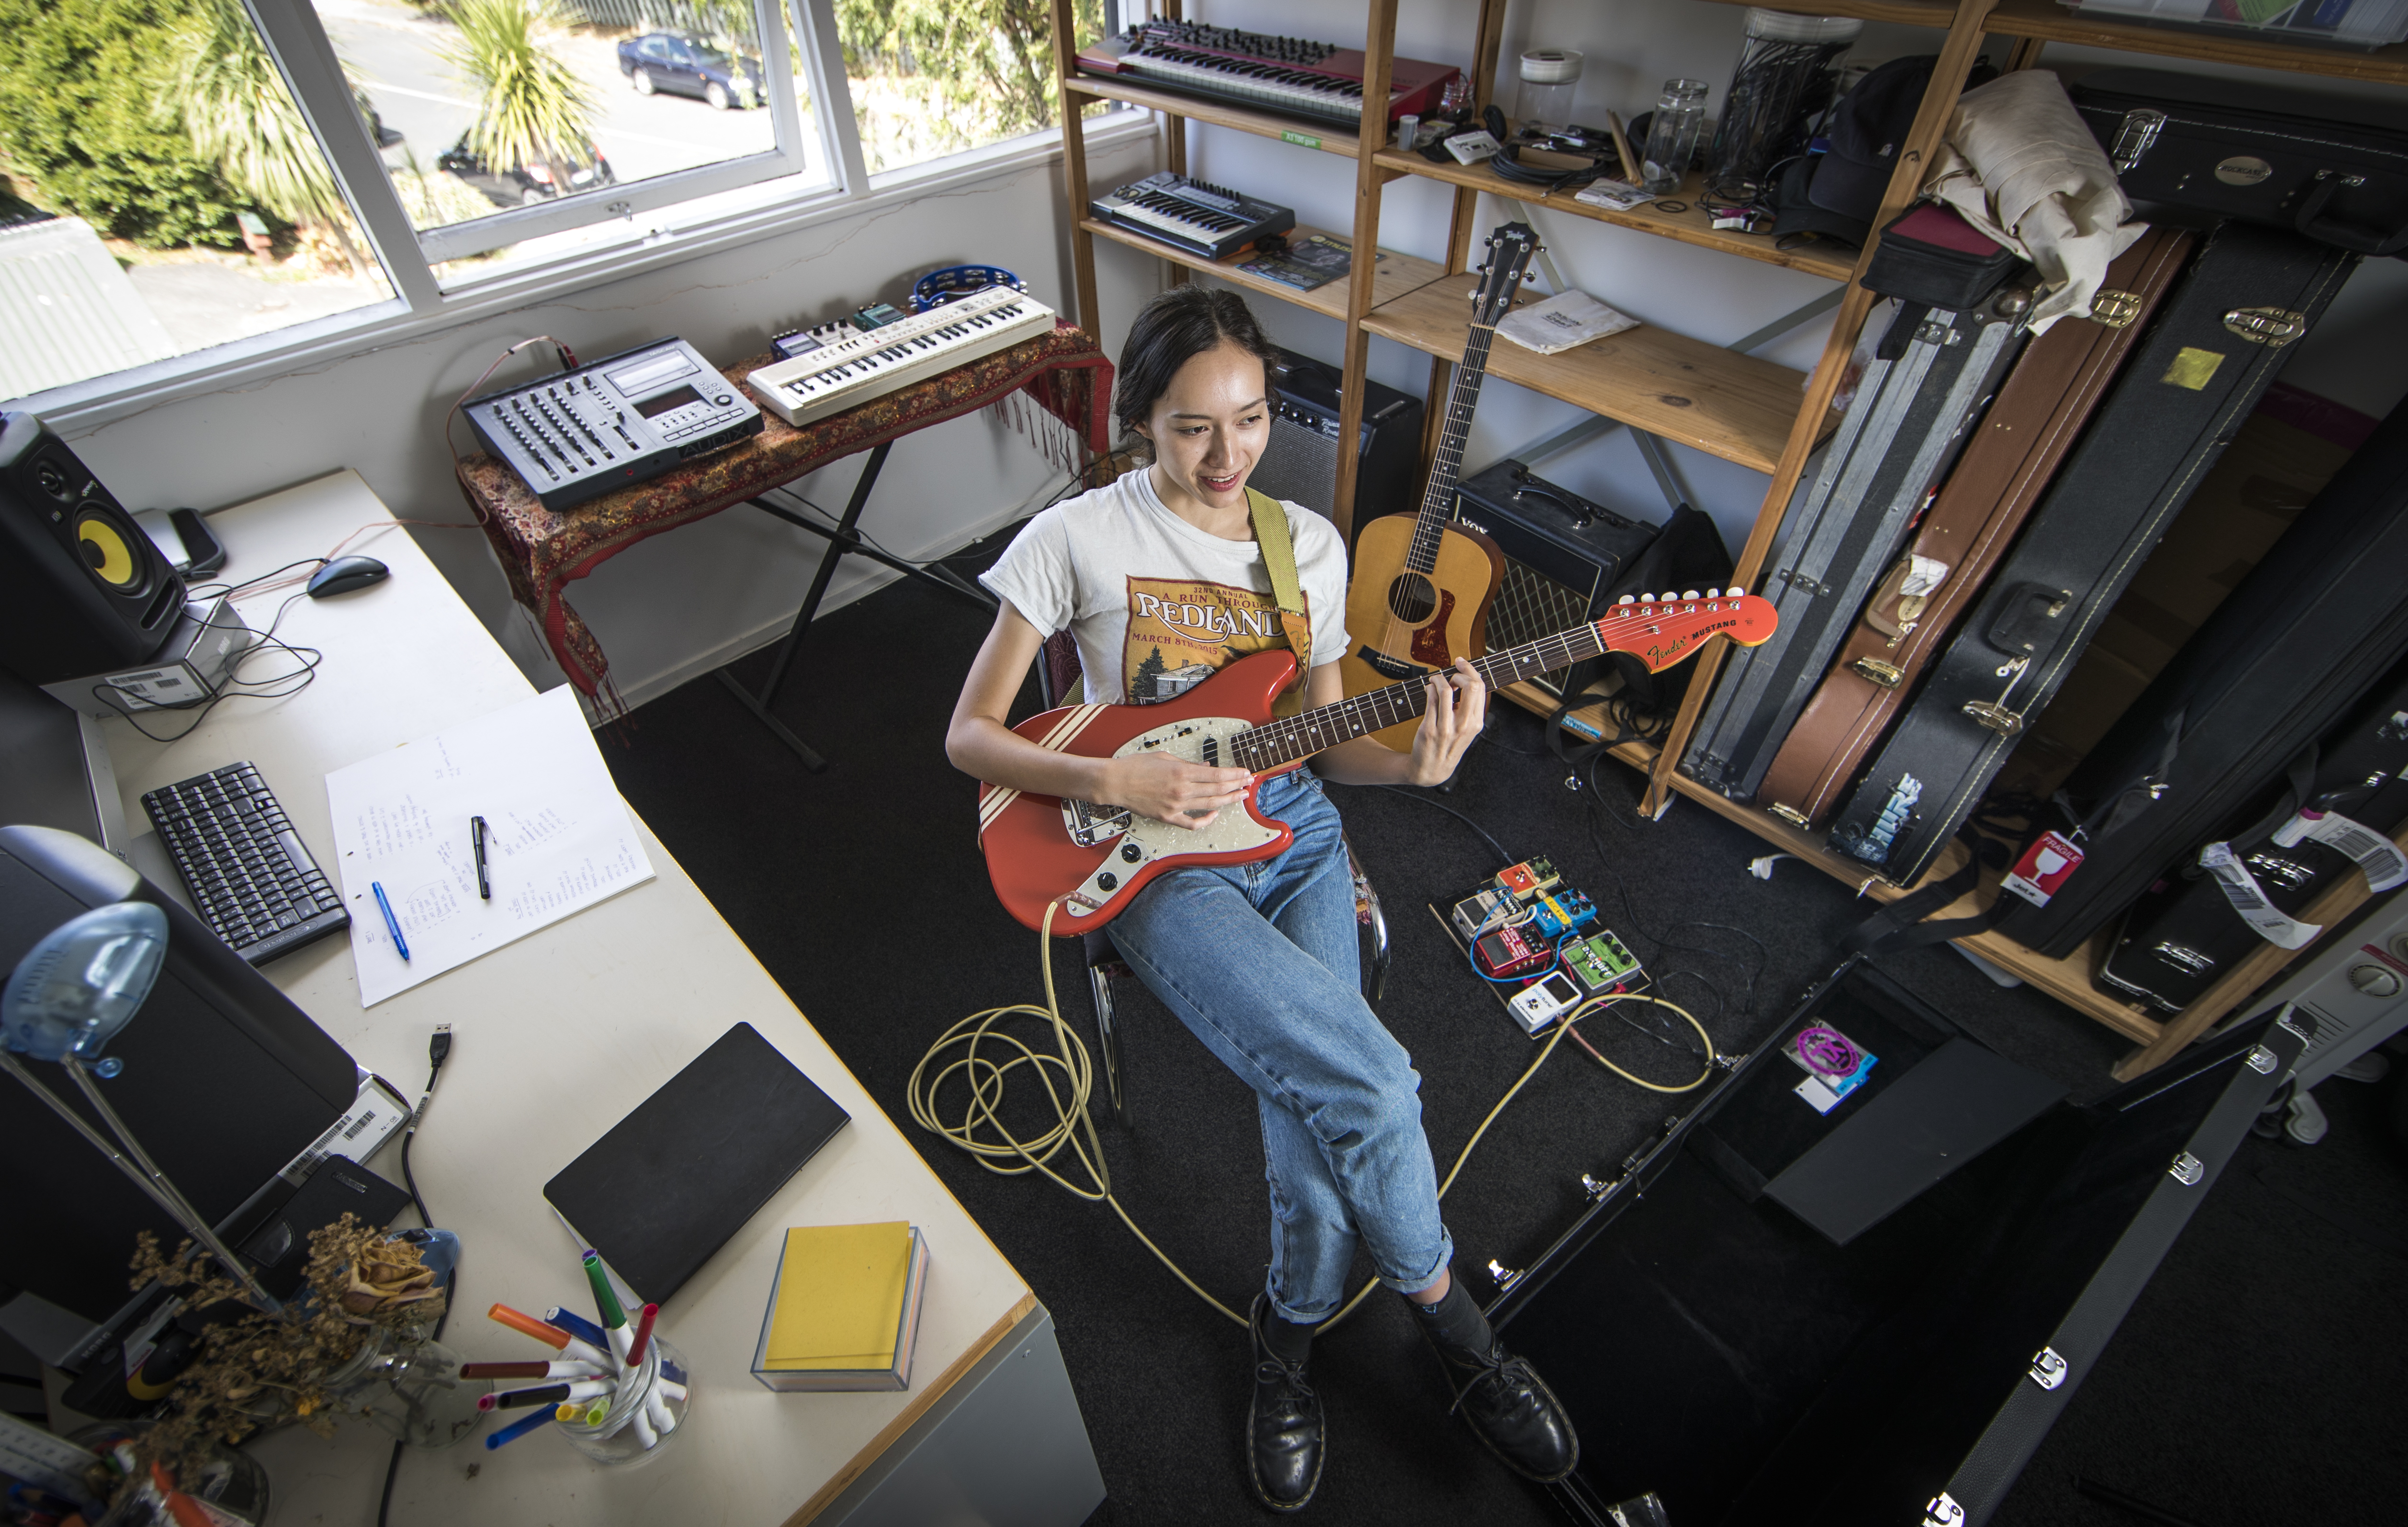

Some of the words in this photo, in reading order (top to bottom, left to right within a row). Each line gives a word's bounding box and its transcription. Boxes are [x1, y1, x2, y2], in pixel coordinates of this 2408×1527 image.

[1505, 230, 1526, 242] Taylor
[649, 346, 676, 357] TASCAM
[684, 426, 746, 457] AUDIX
[1179, 595, 1208, 604] RUN
[1216, 596, 1276, 611] THROUGH
[1217, 589, 1248, 599] ANNUAL
[217, 636, 230, 655] KORG
[1132, 633, 1171, 645] MARCH
[1198, 644, 1218, 655] 2015
[1647, 639, 1688, 665] Fender
[1691, 619, 1737, 640] MUSTANG
[2042, 837, 2081, 864] FRAGILE
[1519, 863, 1539, 886] TOPANGA
[1480, 896, 1497, 917] Equaler
[1548, 901, 1567, 921] ECHO
[264, 932, 297, 948] Logitech
[1592, 956, 1612, 979] MUFF
[1532, 988, 1553, 1008] polytune
[1519, 1004, 1535, 1022] electronic
[1809, 1036, 1847, 1064] XL
[81, 1331, 111, 1358] KORG
[131, 1347, 152, 1369] Kodak
